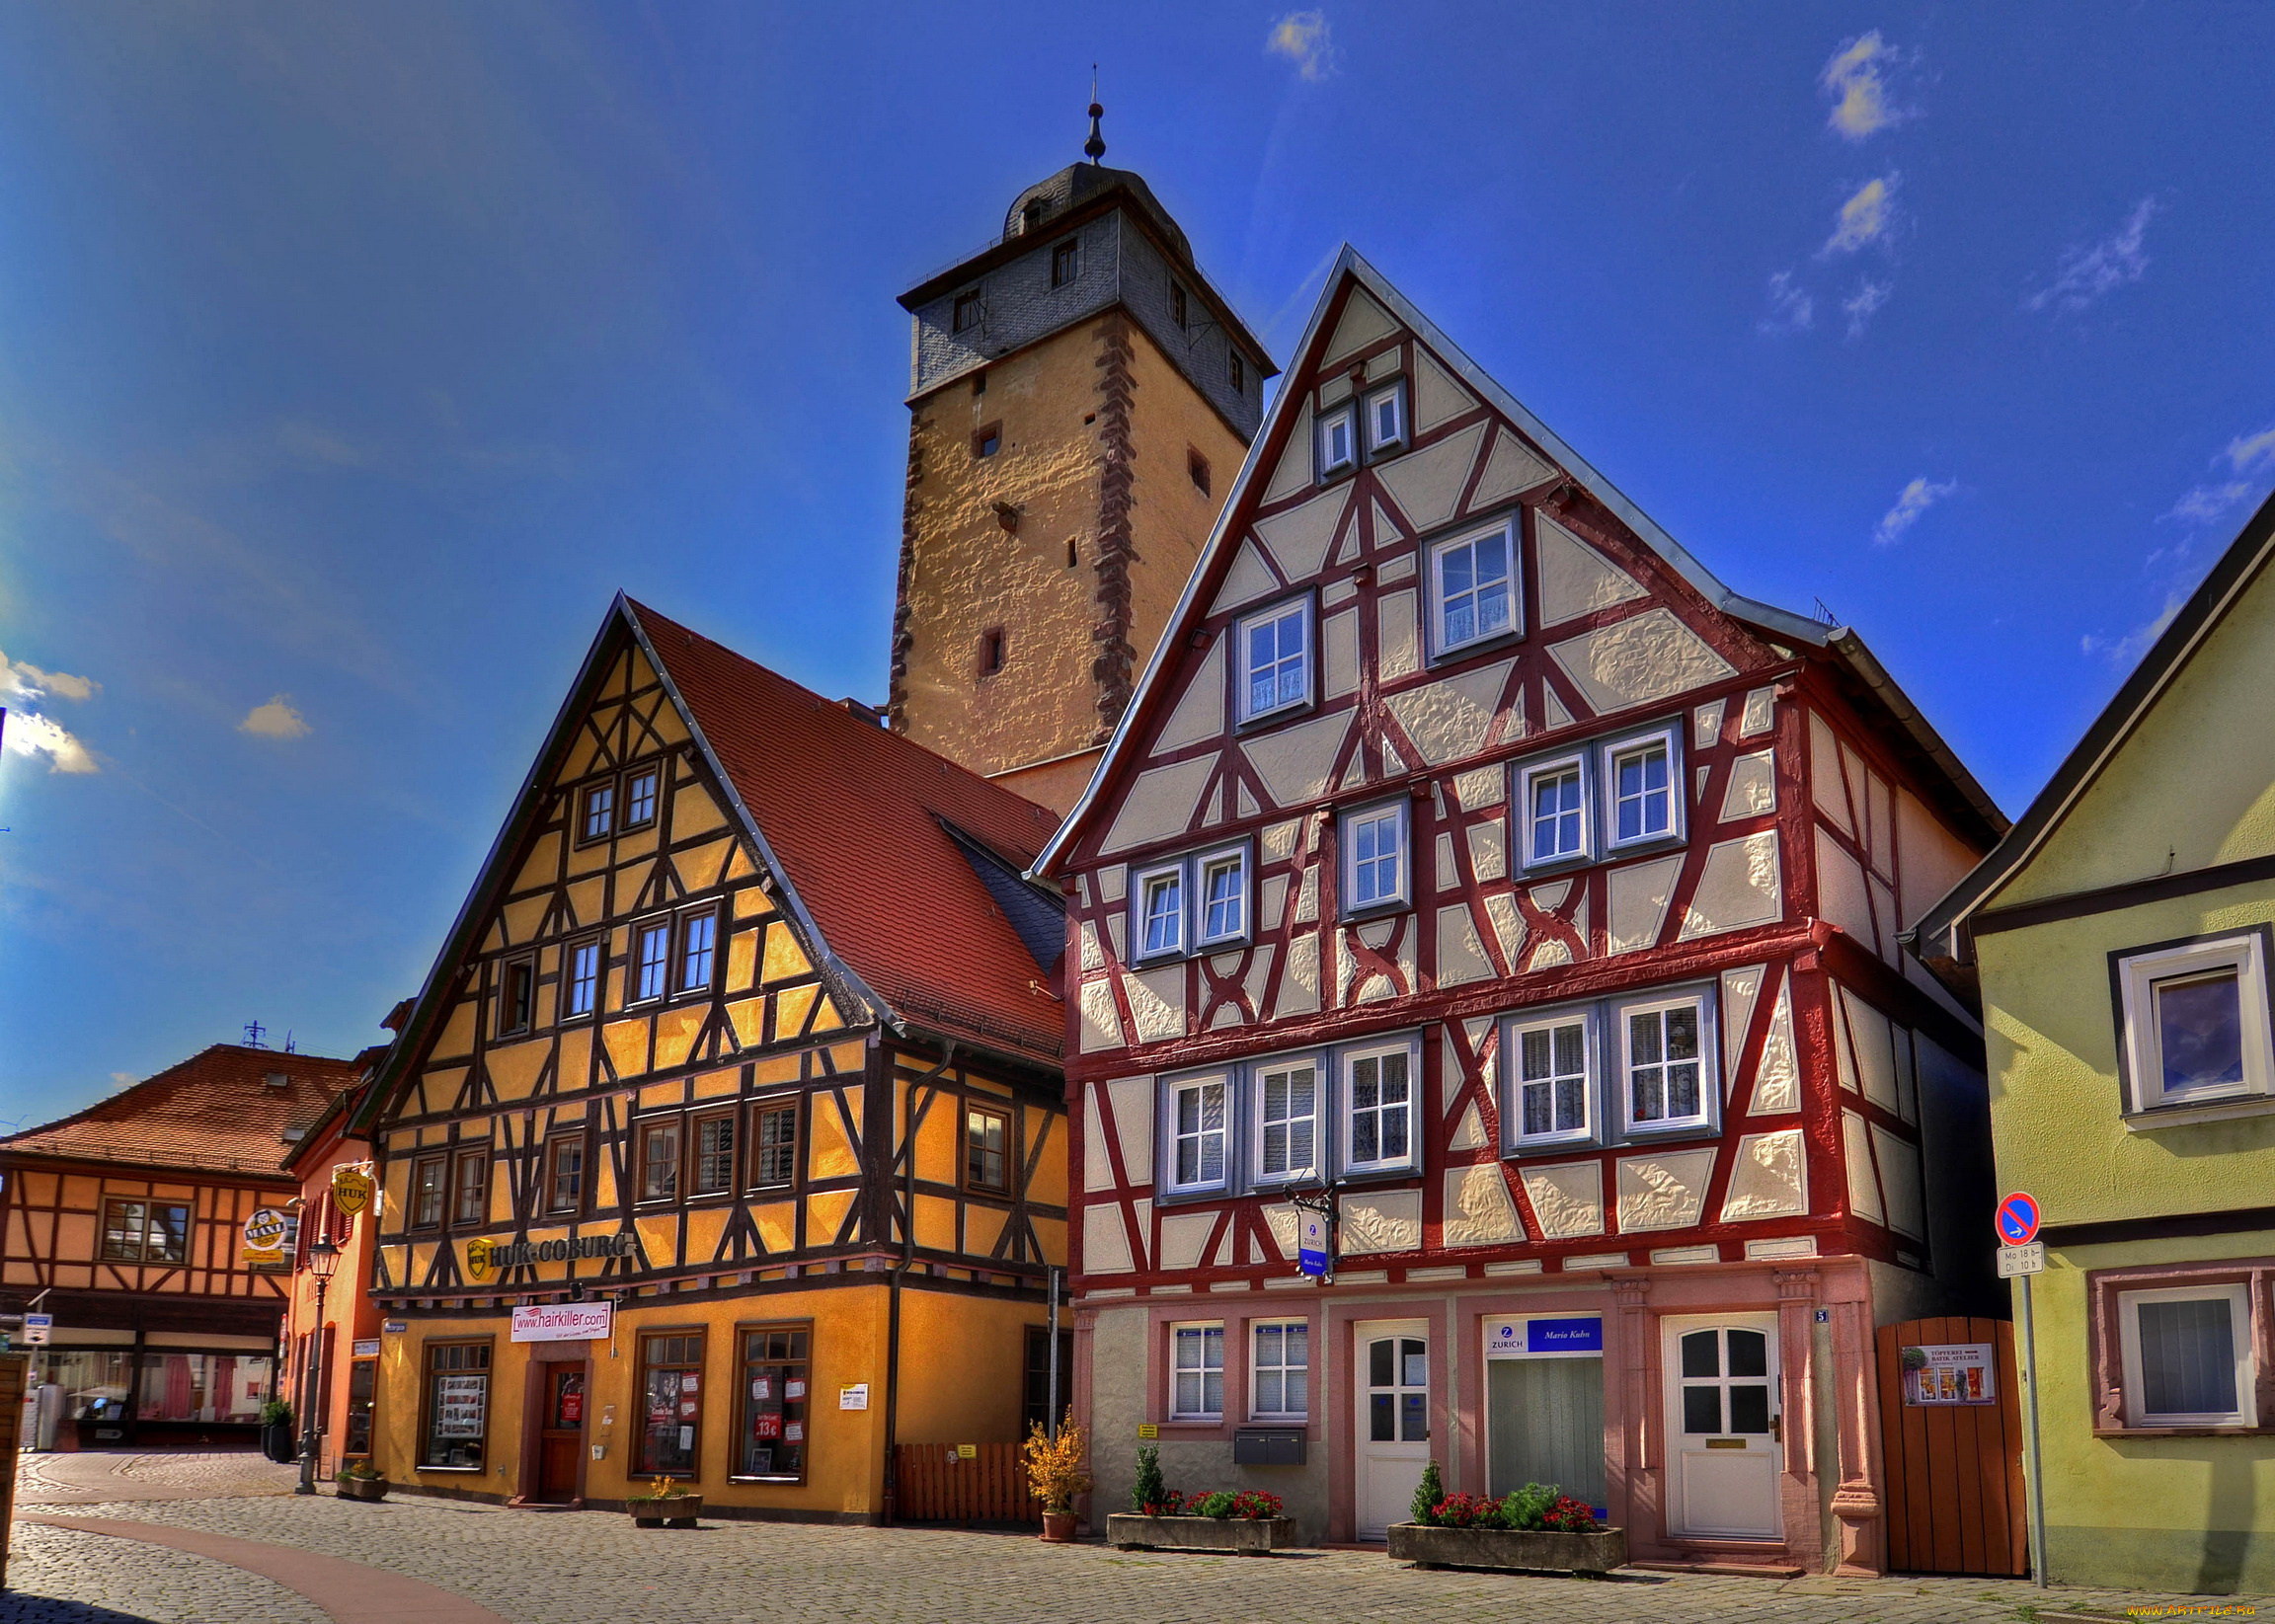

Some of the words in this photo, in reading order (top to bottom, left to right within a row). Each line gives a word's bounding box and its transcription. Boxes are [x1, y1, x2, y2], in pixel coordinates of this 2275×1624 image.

[339, 1188, 366, 1200] HUK
[1303, 1238, 1323, 1247] ZURICH
[490, 1232, 626, 1268] HUK-COBURG
[2020, 1249, 2028, 1258] 18
[469, 1255, 486, 1265] HUK
[2021, 1261, 2029, 1270] 10
[1818, 1311, 1824, 1321] 5
[1569, 1330, 1590, 1339] Kuhn
